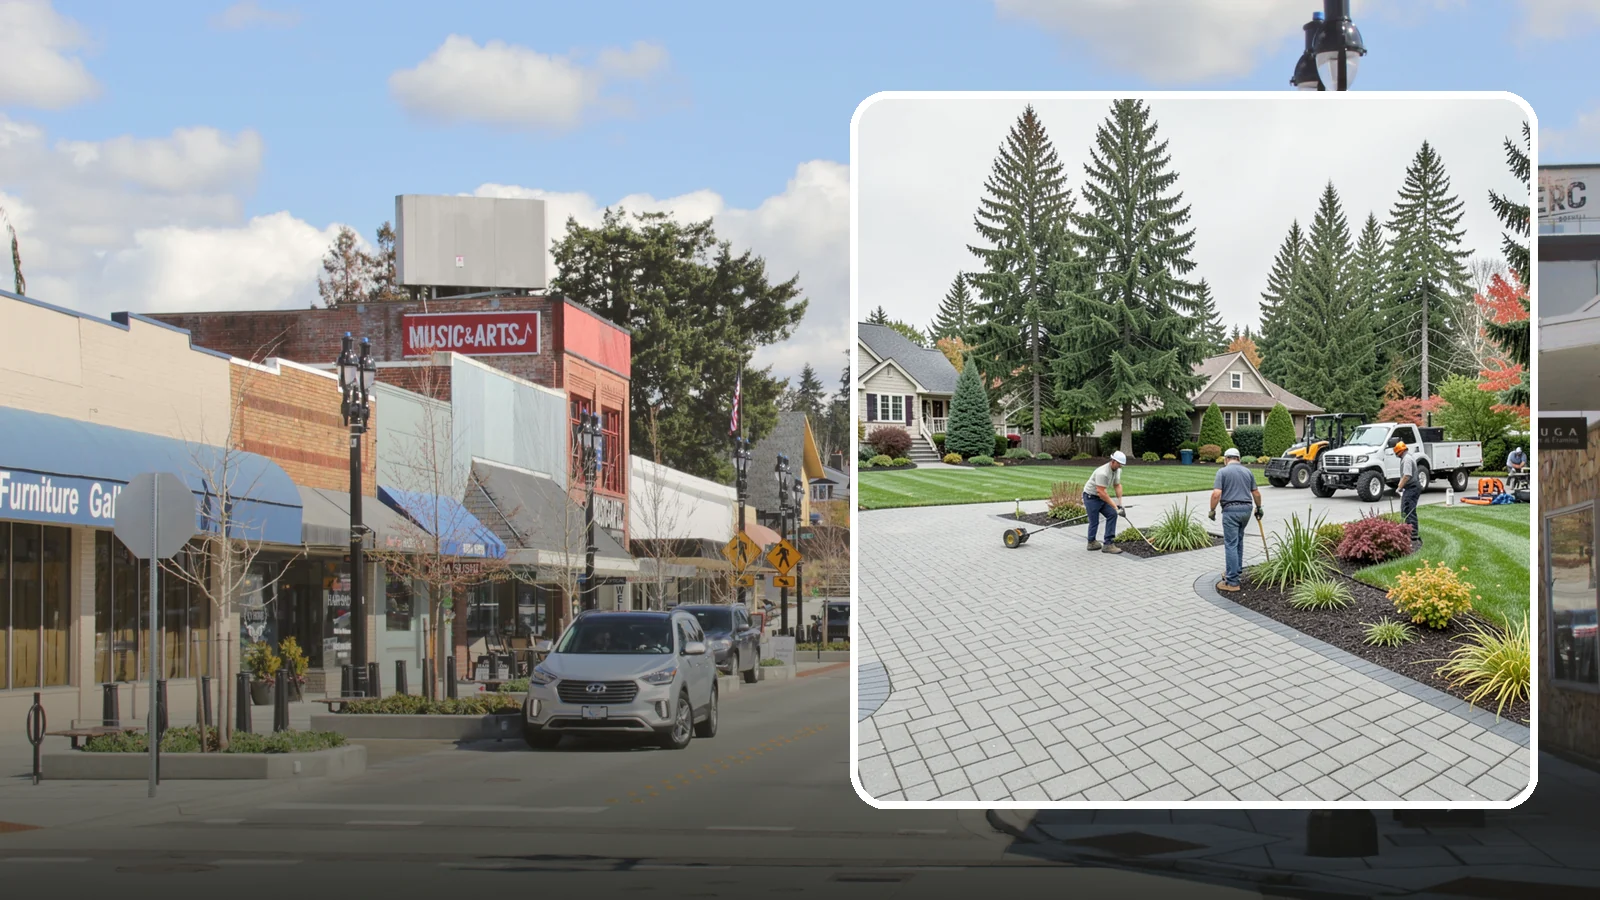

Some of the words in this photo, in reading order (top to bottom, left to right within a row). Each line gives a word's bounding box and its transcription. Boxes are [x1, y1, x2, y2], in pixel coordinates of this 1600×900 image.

[409, 323, 519, 348] MUSIC&ARTS
[0, 472, 79, 515] Furniture
[453, 563, 479, 574] SUSHI
